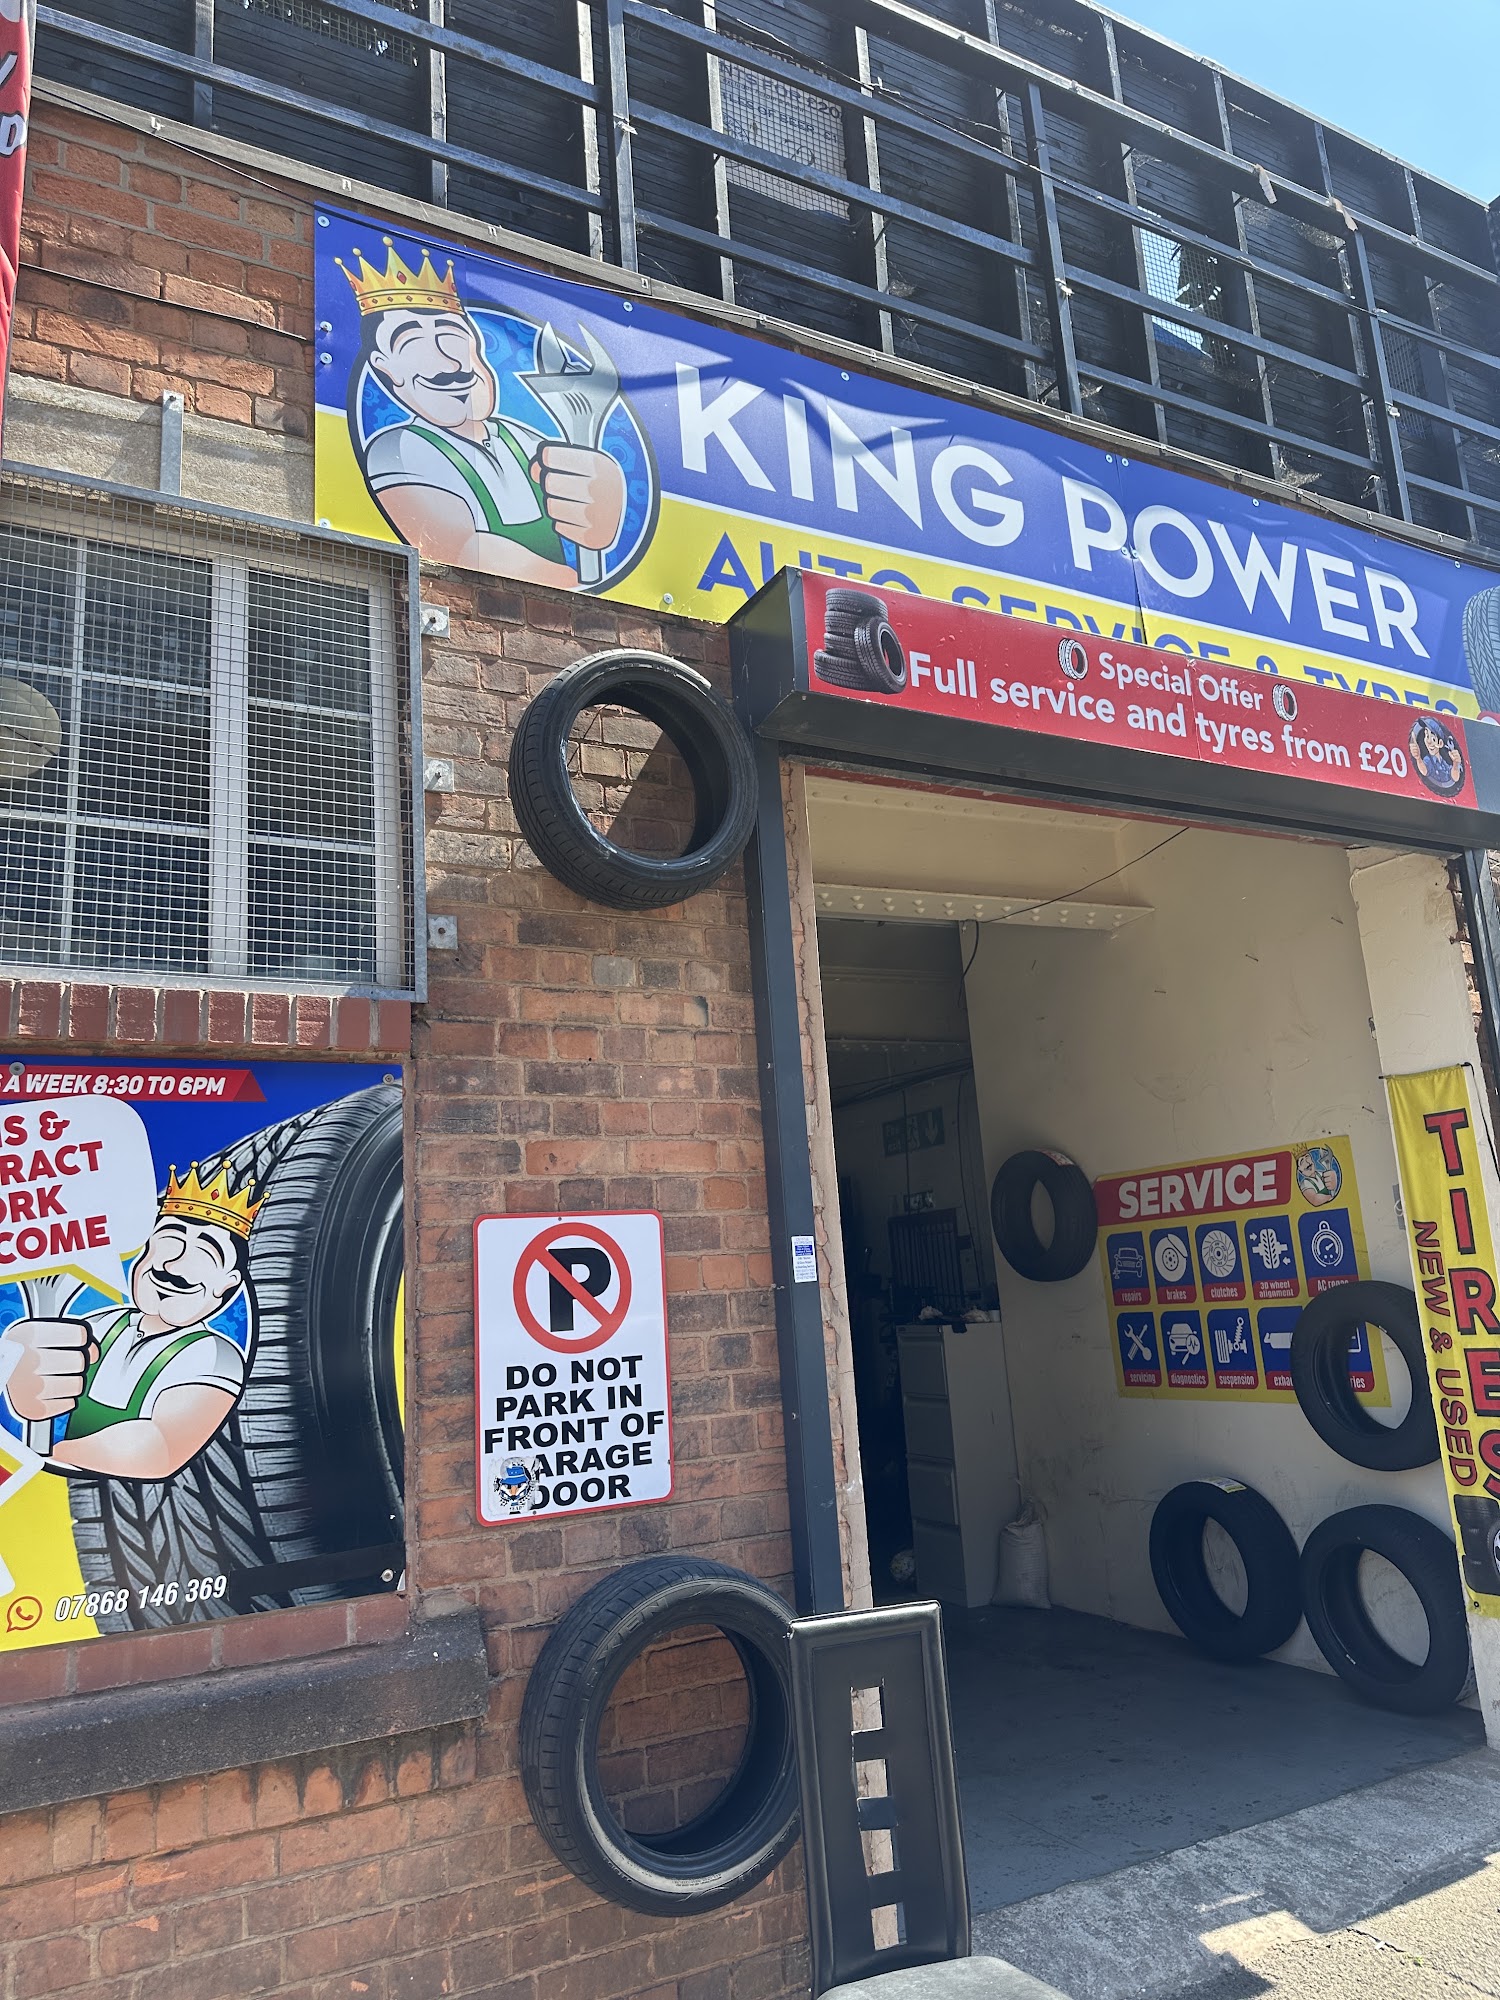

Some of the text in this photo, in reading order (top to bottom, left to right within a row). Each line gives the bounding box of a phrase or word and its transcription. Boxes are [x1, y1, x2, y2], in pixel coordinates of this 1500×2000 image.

[675, 361, 1431, 659] KING POWER
[1100, 652, 1192, 697] Special
[1198, 674, 1265, 712] Offer
[909, 651, 1408, 779] Full service and tyres from £20
[3, 1073, 226, 1096] A WEEK 8:30 TO 6PM
[39, 1110, 71, 1141] &
[0, 1184, 68, 1224] RK
[1118, 1159, 1278, 1219] SERVICE
[1122, 1291, 1142, 1303] repairs
[1166, 1288, 1187, 1300] brakes
[1210, 1286, 1238, 1298] clutches
[1259, 1288, 1294, 1299] alignment
[1270, 1280, 1291, 1289] wheel
[1317, 1279, 1328, 1291] AC
[1412, 1219, 1478, 1487] NEW & USED
[506, 1355, 643, 1390] DO NOT
[1130, 1372, 1156, 1384] servicing
[1170, 1373, 1207, 1386] diagnostics
[1219, 1373, 1254, 1387] suspension
[496, 1383, 642, 1422] PARK IN
[484, 1410, 664, 1454] FRONT OF
[531, 1441, 652, 1479] ARAGE
[55, 1575, 227, 1621] 07868 146 369
